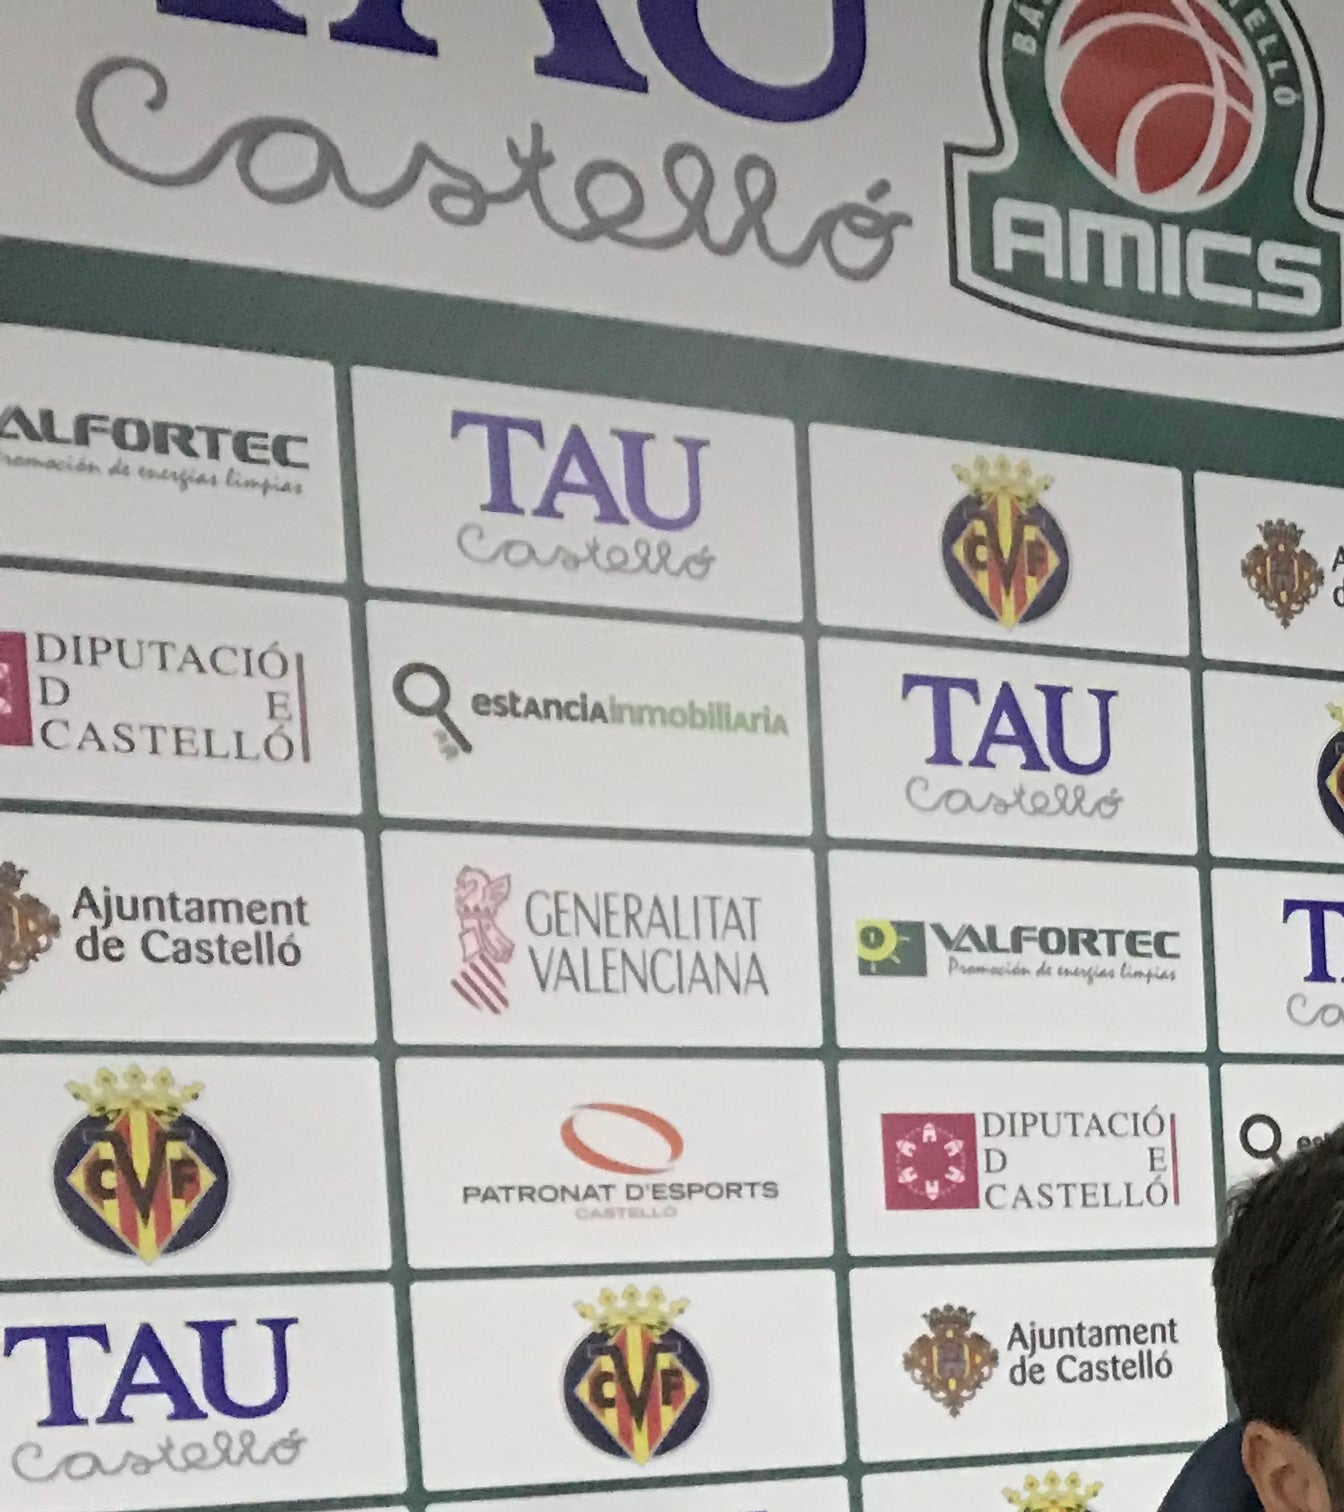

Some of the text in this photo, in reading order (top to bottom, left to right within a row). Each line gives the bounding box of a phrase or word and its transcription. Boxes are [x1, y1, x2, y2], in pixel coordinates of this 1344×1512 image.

[75, 56, 912, 282] Castelló
[992, 198, 1321, 317] AMICS
[0, 405, 309, 469] ALFORTEC
[0, 452, 100, 474] romoción
[450, 410, 710, 533] TAU
[457, 522, 716, 579] Castelló
[35, 632, 288, 680] DIPUTACIÓ
[40, 717, 295, 762] CASTELLÓ
[901, 674, 1118, 776] TAU
[905, 775, 1124, 821] Castelló
[70, 884, 310, 927] Ajuntament
[525, 889, 761, 942] GENERALITAT
[76, 928, 302, 967] de Castelló
[930, 923, 1180, 958] VALFORTEC
[527, 945, 769, 996] VALENCIANA
[1036, 962, 1051, 976] de
[1120, 962, 1175, 984] limpias
[983, 1105, 1164, 1138] DIPUTACIÓ
[462, 1180, 779, 1204] PATRONAT D'ESPORTS
[985, 1175, 1168, 1211] CASTELLÓ
[1007, 1318, 1179, 1358] Ajuntament
[3, 1316, 299, 1427] TAU
[1008, 1349, 1172, 1387] de Castelló
[12, 1427, 308, 1482] Castelló
